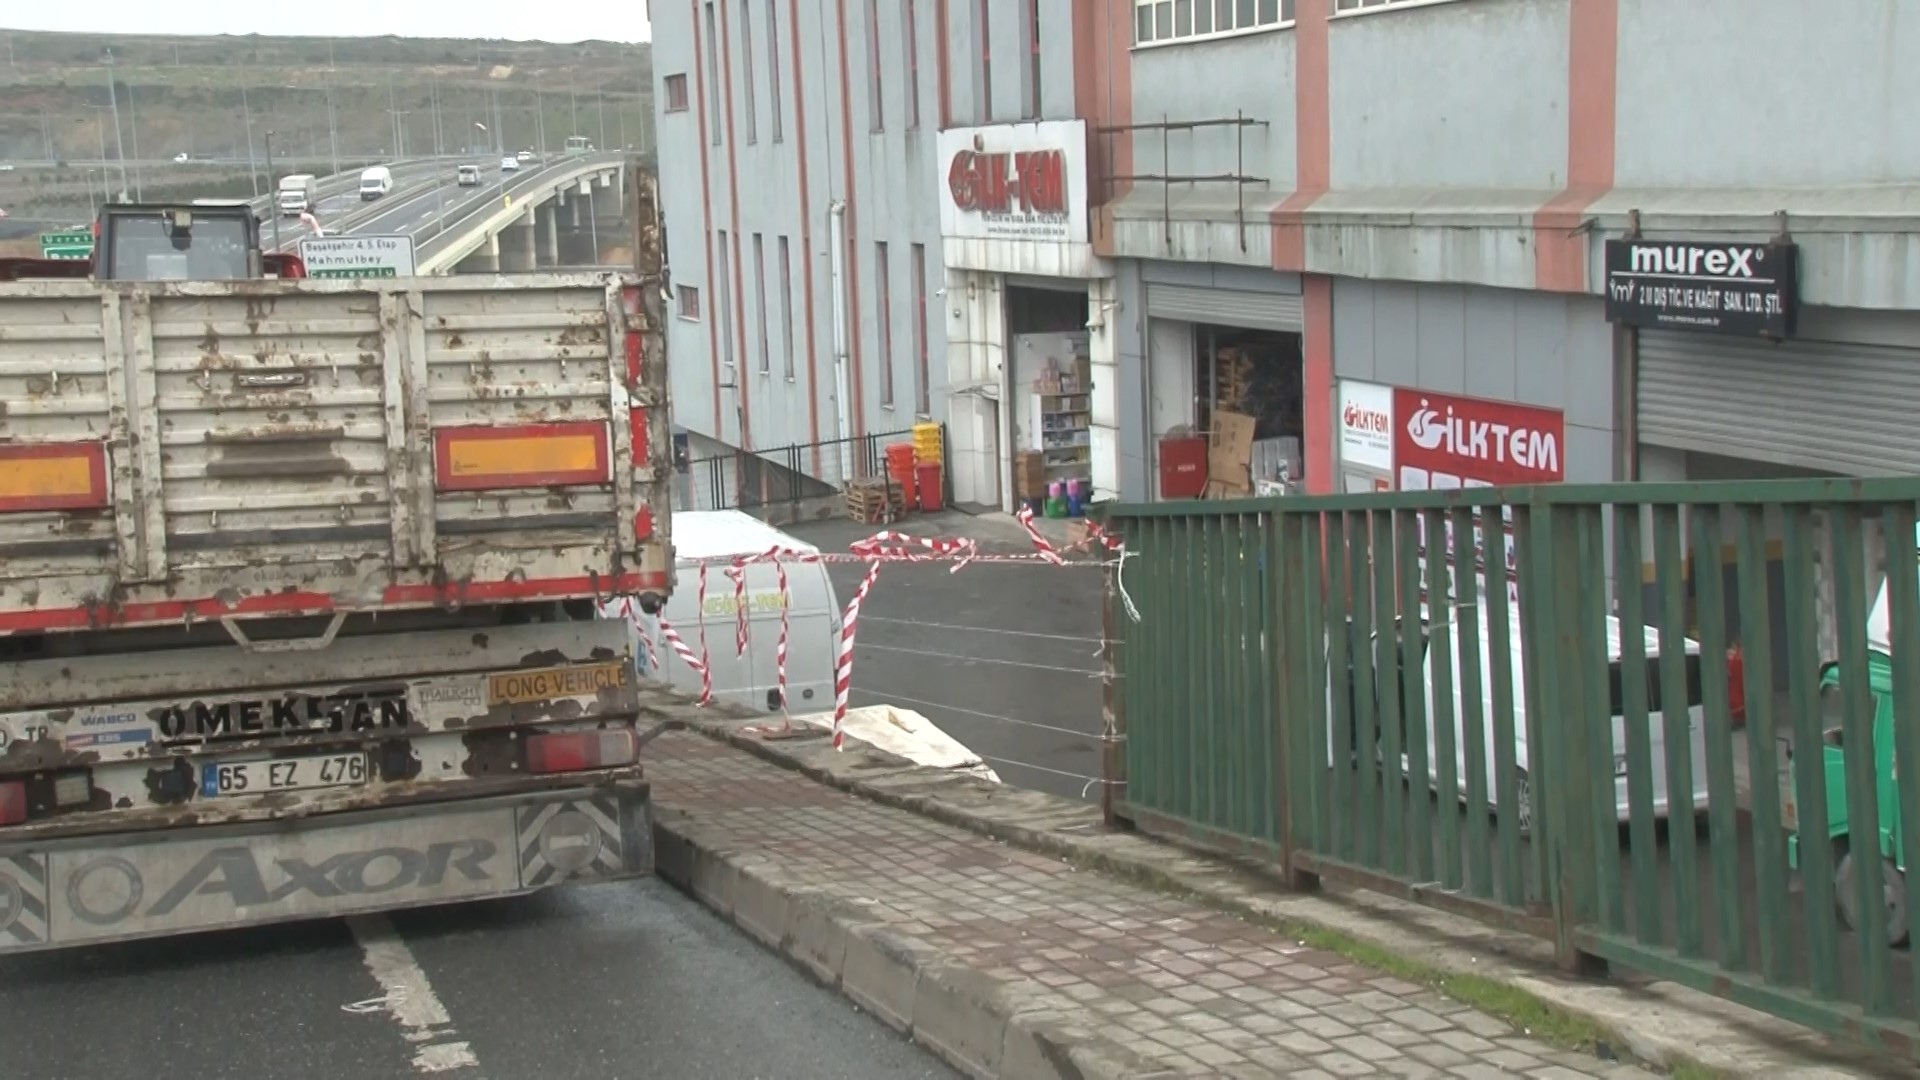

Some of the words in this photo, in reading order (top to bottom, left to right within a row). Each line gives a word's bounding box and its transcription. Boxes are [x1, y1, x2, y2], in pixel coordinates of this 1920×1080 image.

[377, 239, 397, 250] Etap
[308, 256, 382, 265] Mahmutbey
[1631, 245, 1753, 277] murex
[1695, 285, 1720, 310] KAĞIT
[495, 675, 547, 698] LONG
[553, 667, 628, 693] VEHICLE
[81, 713, 136, 726] WABCO
[218, 765, 247, 791] 65
[269, 761, 298, 788] EZ
[320, 756, 362, 783] 476
